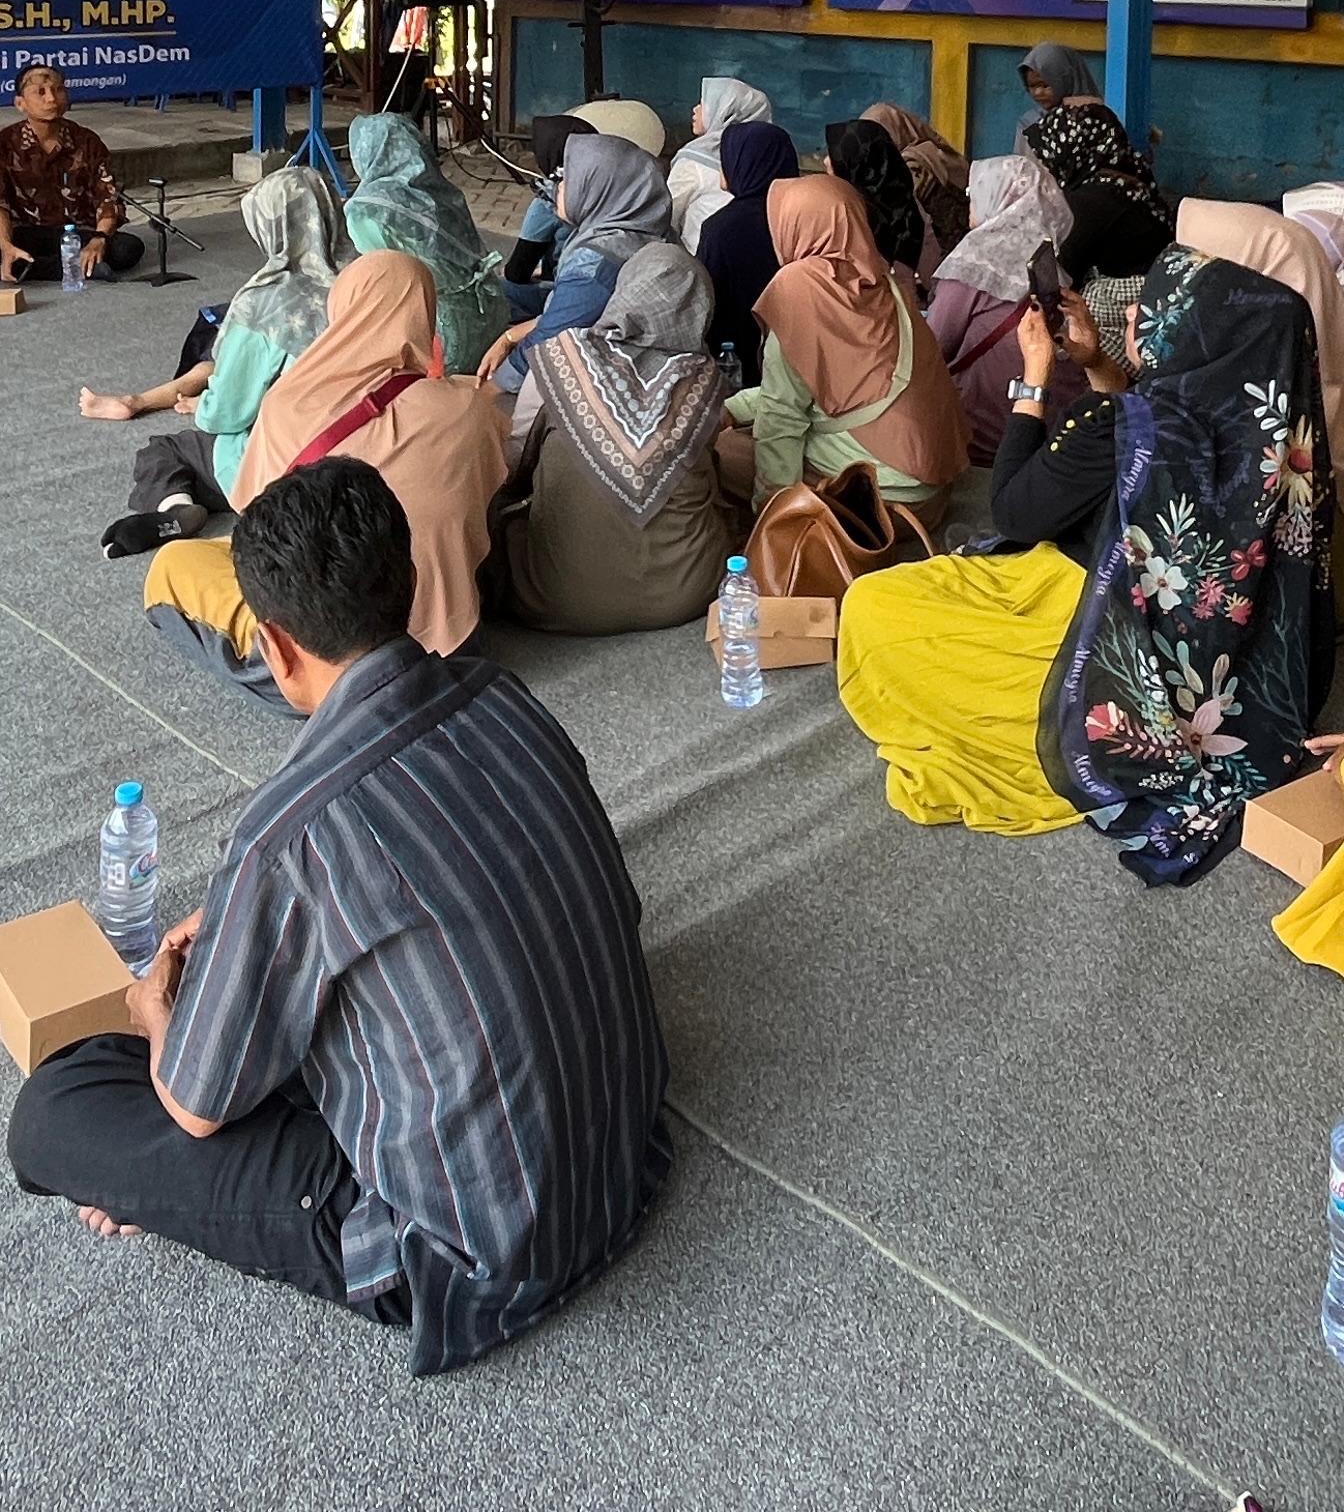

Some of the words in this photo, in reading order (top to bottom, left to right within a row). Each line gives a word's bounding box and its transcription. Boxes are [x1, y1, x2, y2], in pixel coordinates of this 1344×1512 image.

[82, 0, 176, 27] M.HP.
[15, 42, 89, 69] Partai
[102, 44, 191, 66] NasDem
[64, 73, 127, 88] amongan)
